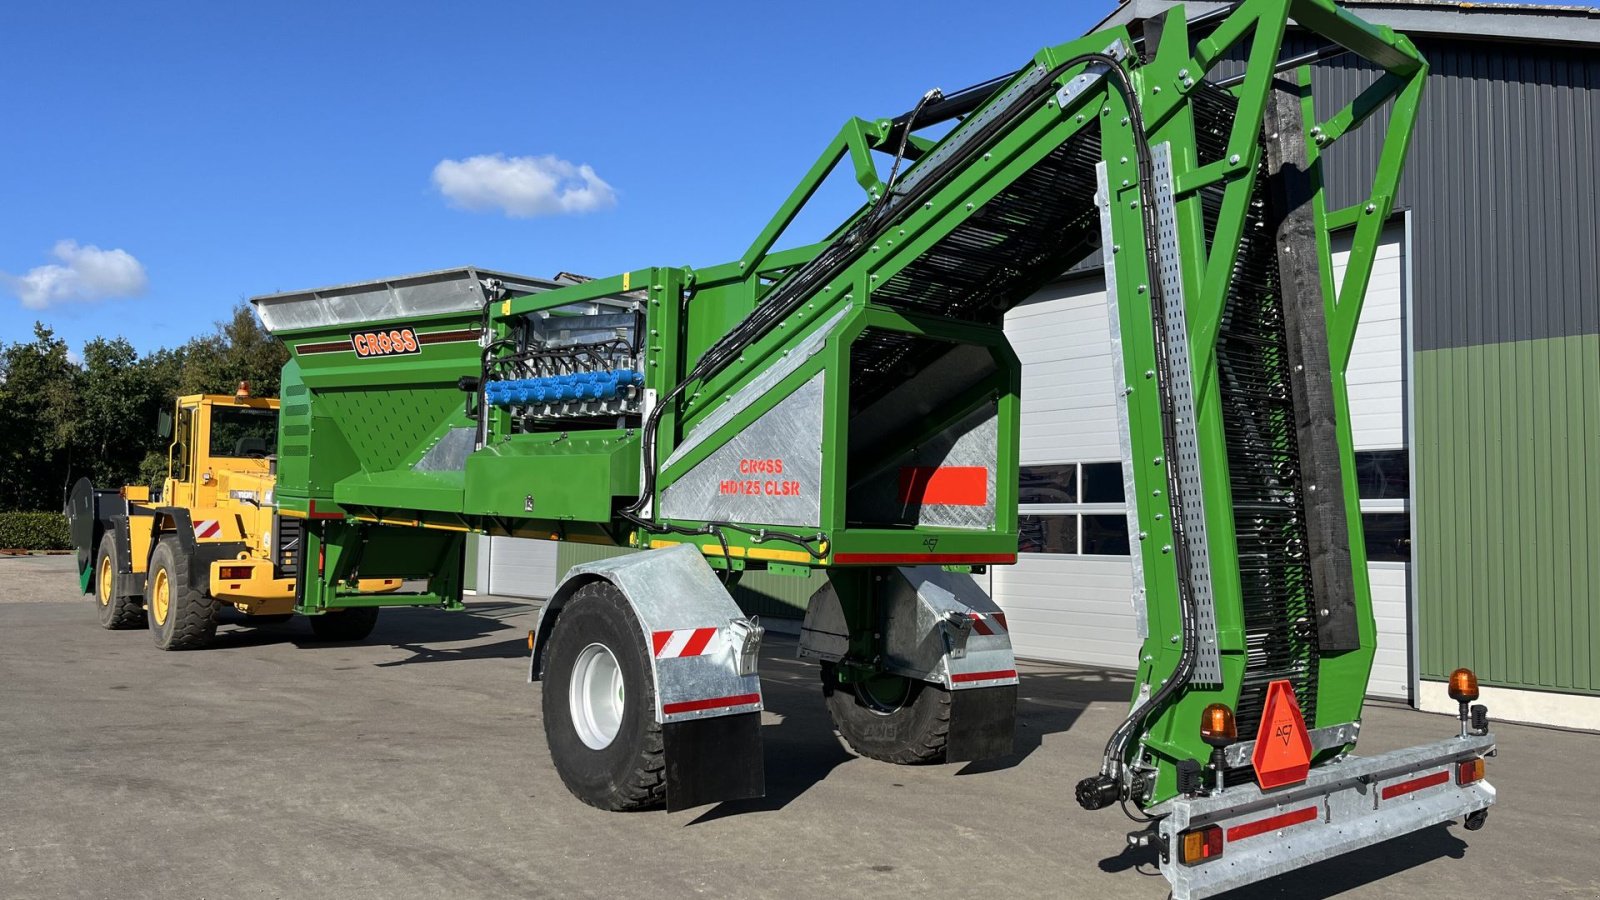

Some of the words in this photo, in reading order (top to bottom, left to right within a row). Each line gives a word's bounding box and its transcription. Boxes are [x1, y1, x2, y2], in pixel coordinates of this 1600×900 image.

[354, 329, 417, 356] CROSS
[740, 458, 783, 474] CROSS
[720, 480, 761, 495] HD125
[764, 480, 800, 496] CLSR
